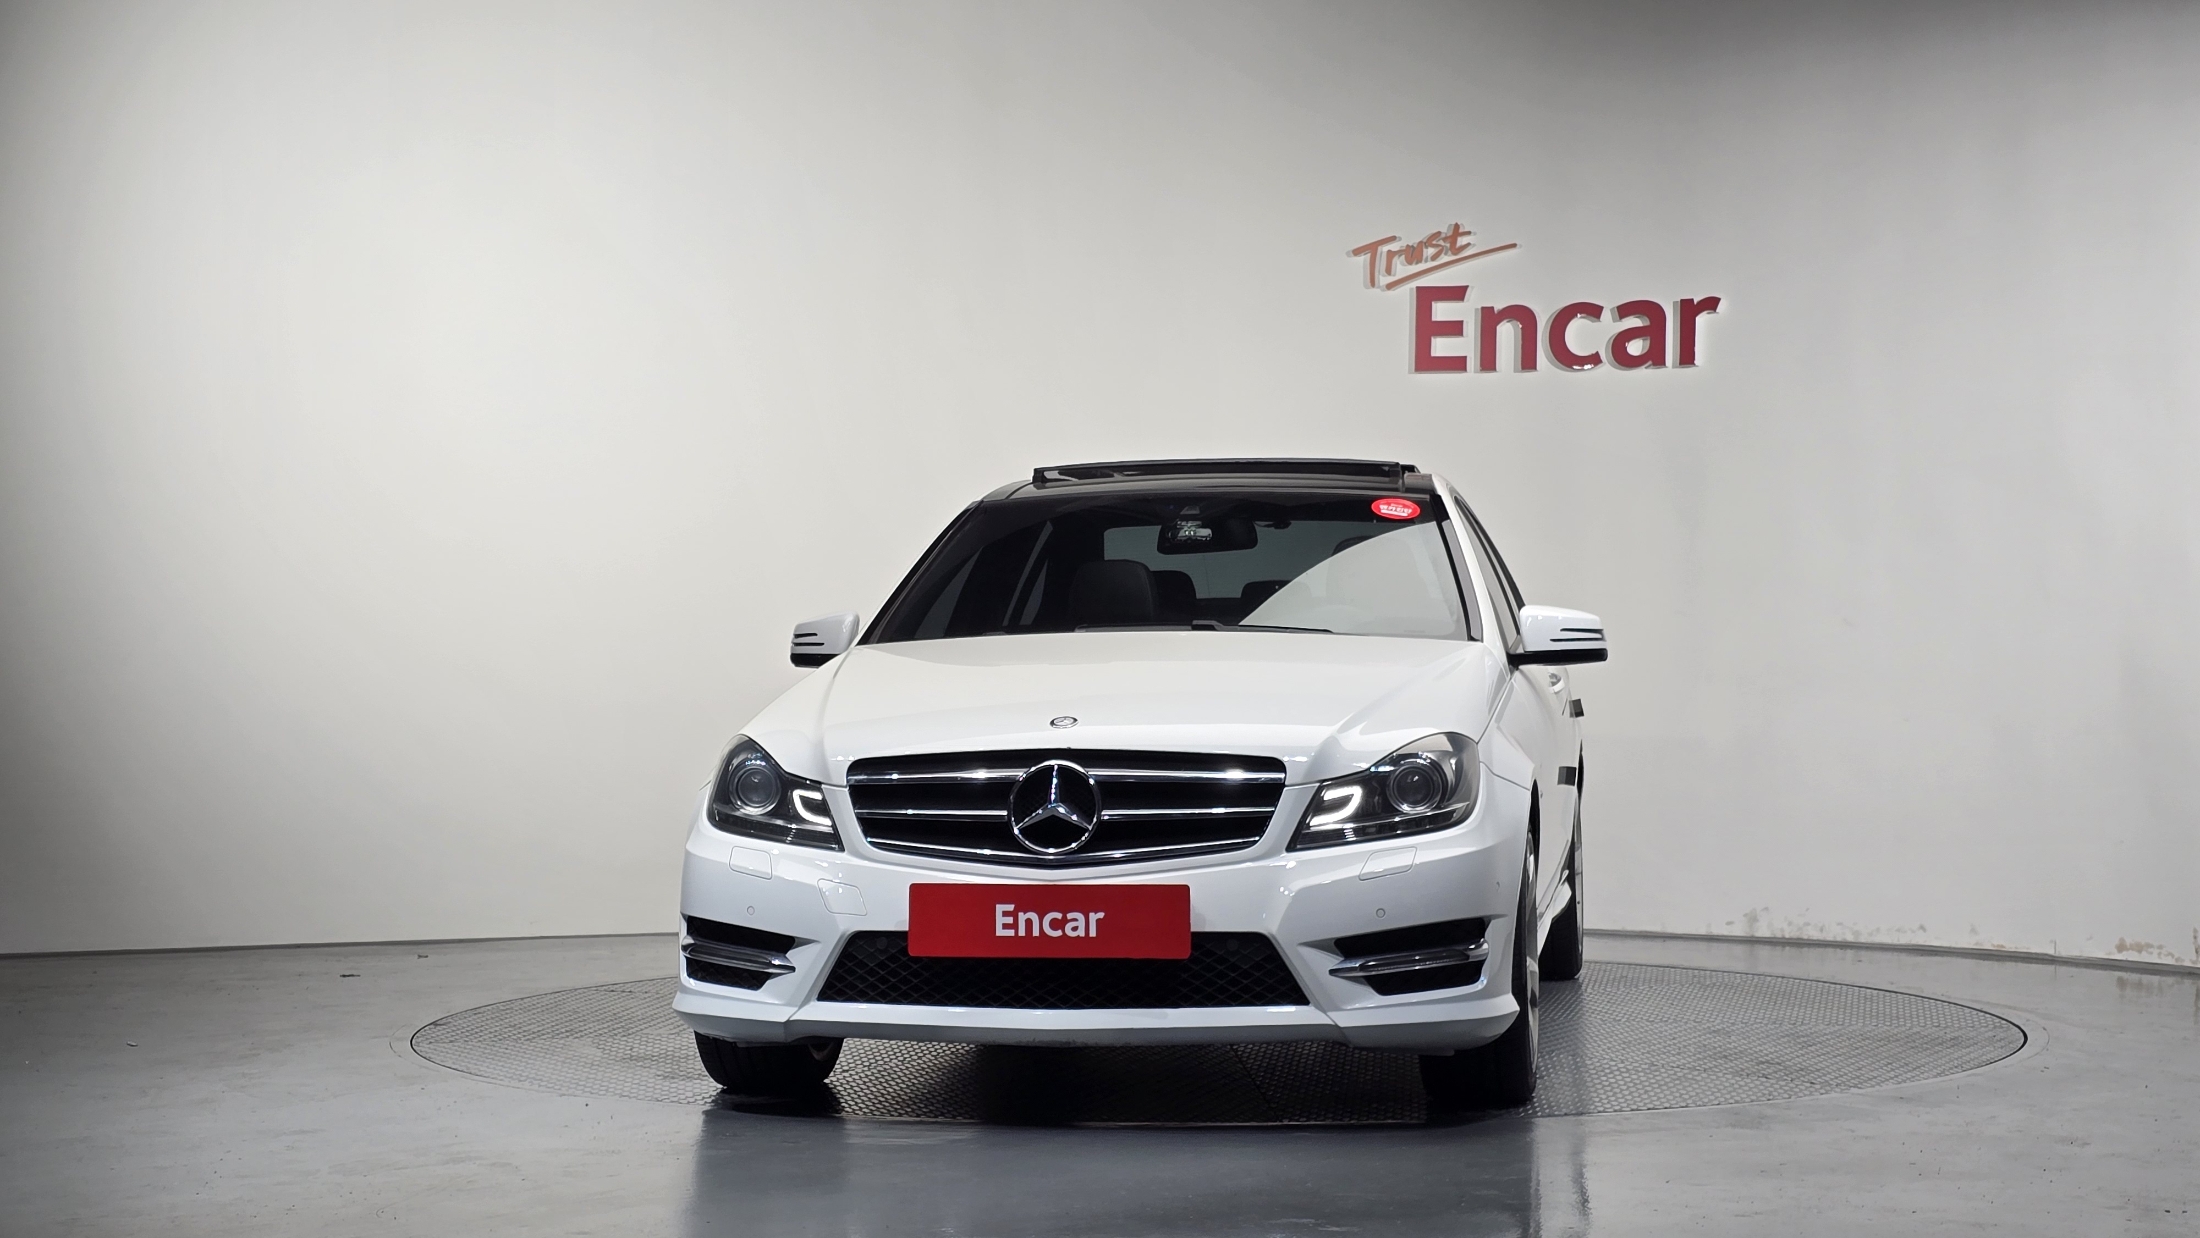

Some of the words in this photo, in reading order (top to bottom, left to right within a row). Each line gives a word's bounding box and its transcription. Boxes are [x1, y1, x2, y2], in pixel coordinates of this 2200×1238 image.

[1350, 222, 1474, 288] Trust
[1411, 285, 1721, 373] Encar
[995, 903, 1105, 937] Encar
